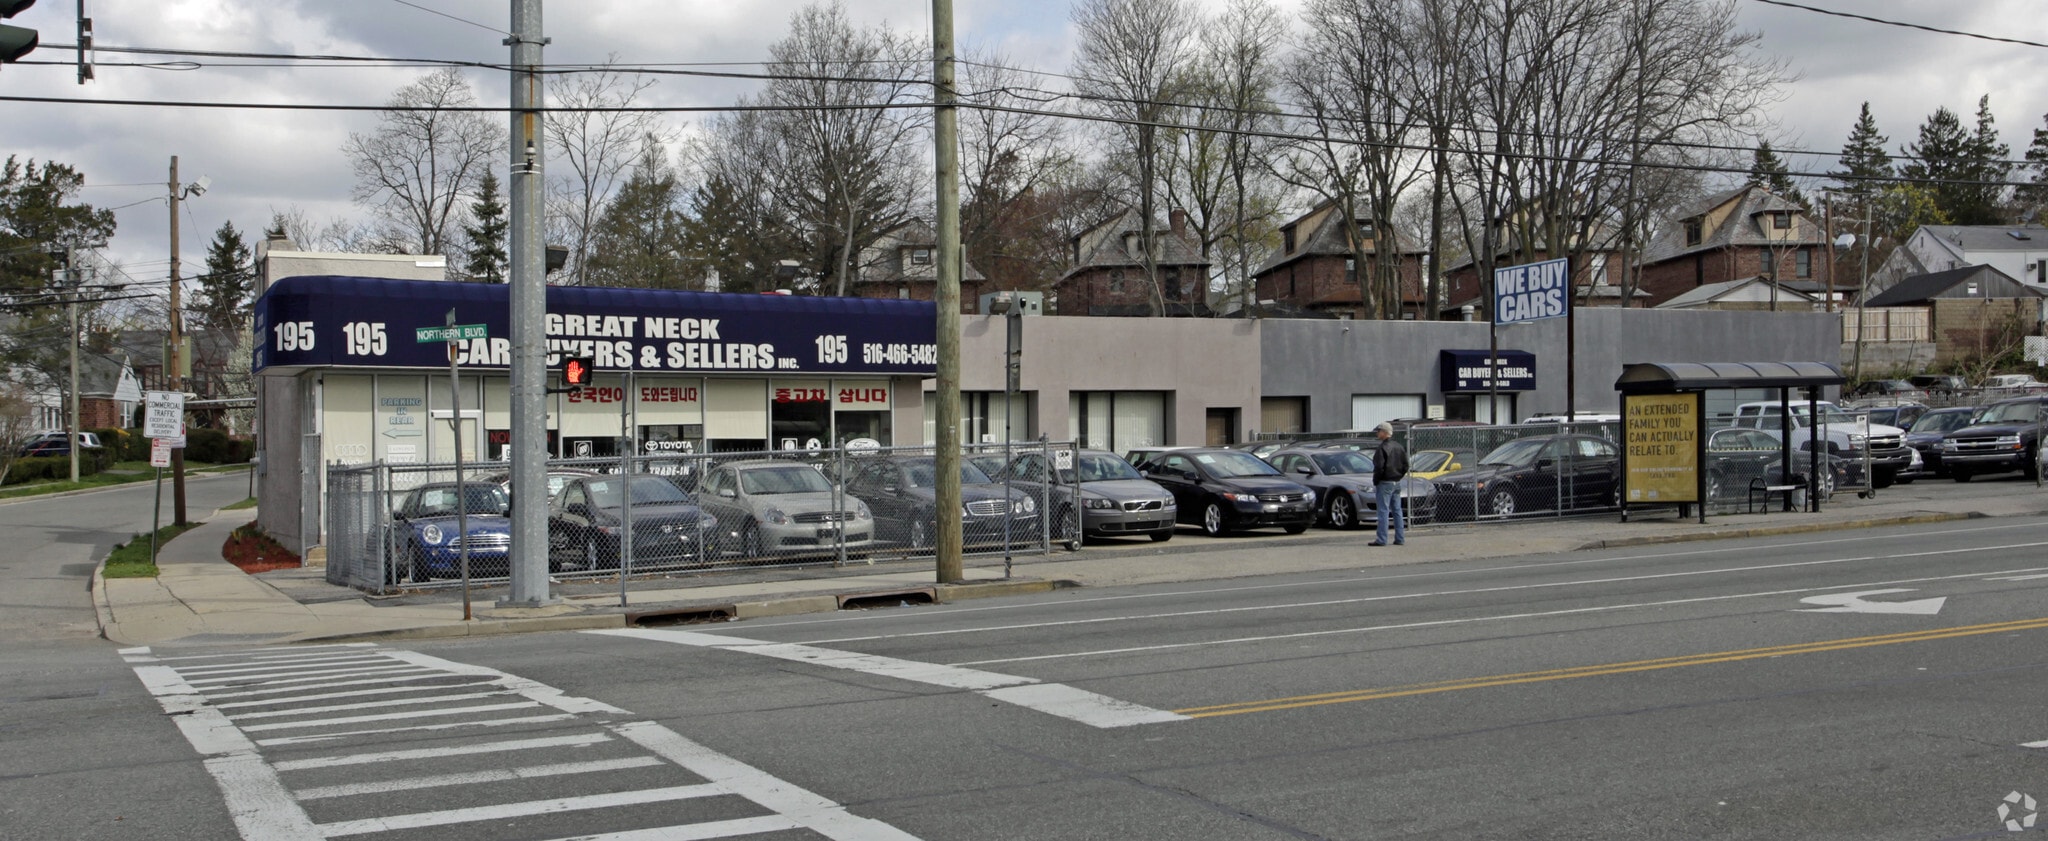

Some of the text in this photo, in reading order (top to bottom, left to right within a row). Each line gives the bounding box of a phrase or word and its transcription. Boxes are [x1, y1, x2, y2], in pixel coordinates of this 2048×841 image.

[1497, 261, 1565, 295] WE BUY
[1500, 288, 1562, 322] CARS
[545, 313, 720, 339] GREAT NECK
[274, 321, 315, 351] 195
[342, 321, 388, 356] 195
[416, 327, 487, 340] NORTHERN BLVD.
[447, 337, 510, 365] CAR
[640, 345, 661, 368] &
[667, 341, 775, 369] SELLERS
[778, 357, 800, 369] INC.
[815, 335, 848, 364] 195
[863, 343, 937, 365] 516-466-5482
[1459, 367, 1472, 378] CAR
[1503, 367, 1528, 378] SELLERS
[641, 387, 698, 402] 도와드립니다
[775, 388, 887, 403] 중고차 삽니다
[149, 401, 180, 410] COMMERCIAL
[381, 397, 422, 406] PARKING
[396, 407, 407, 416] IN
[1629, 403, 1690, 416] AN EXTENDED
[389, 416, 414, 425] REAR
[1629, 417, 1681, 429] FAMILY YOU
[1629, 430, 1694, 442] CAN ACTUALLY
[658, 441, 693, 450] TOYOTA
[1629, 444, 1678, 456] RELATE TO.
[649, 466, 690, 476] TRADE-IN
